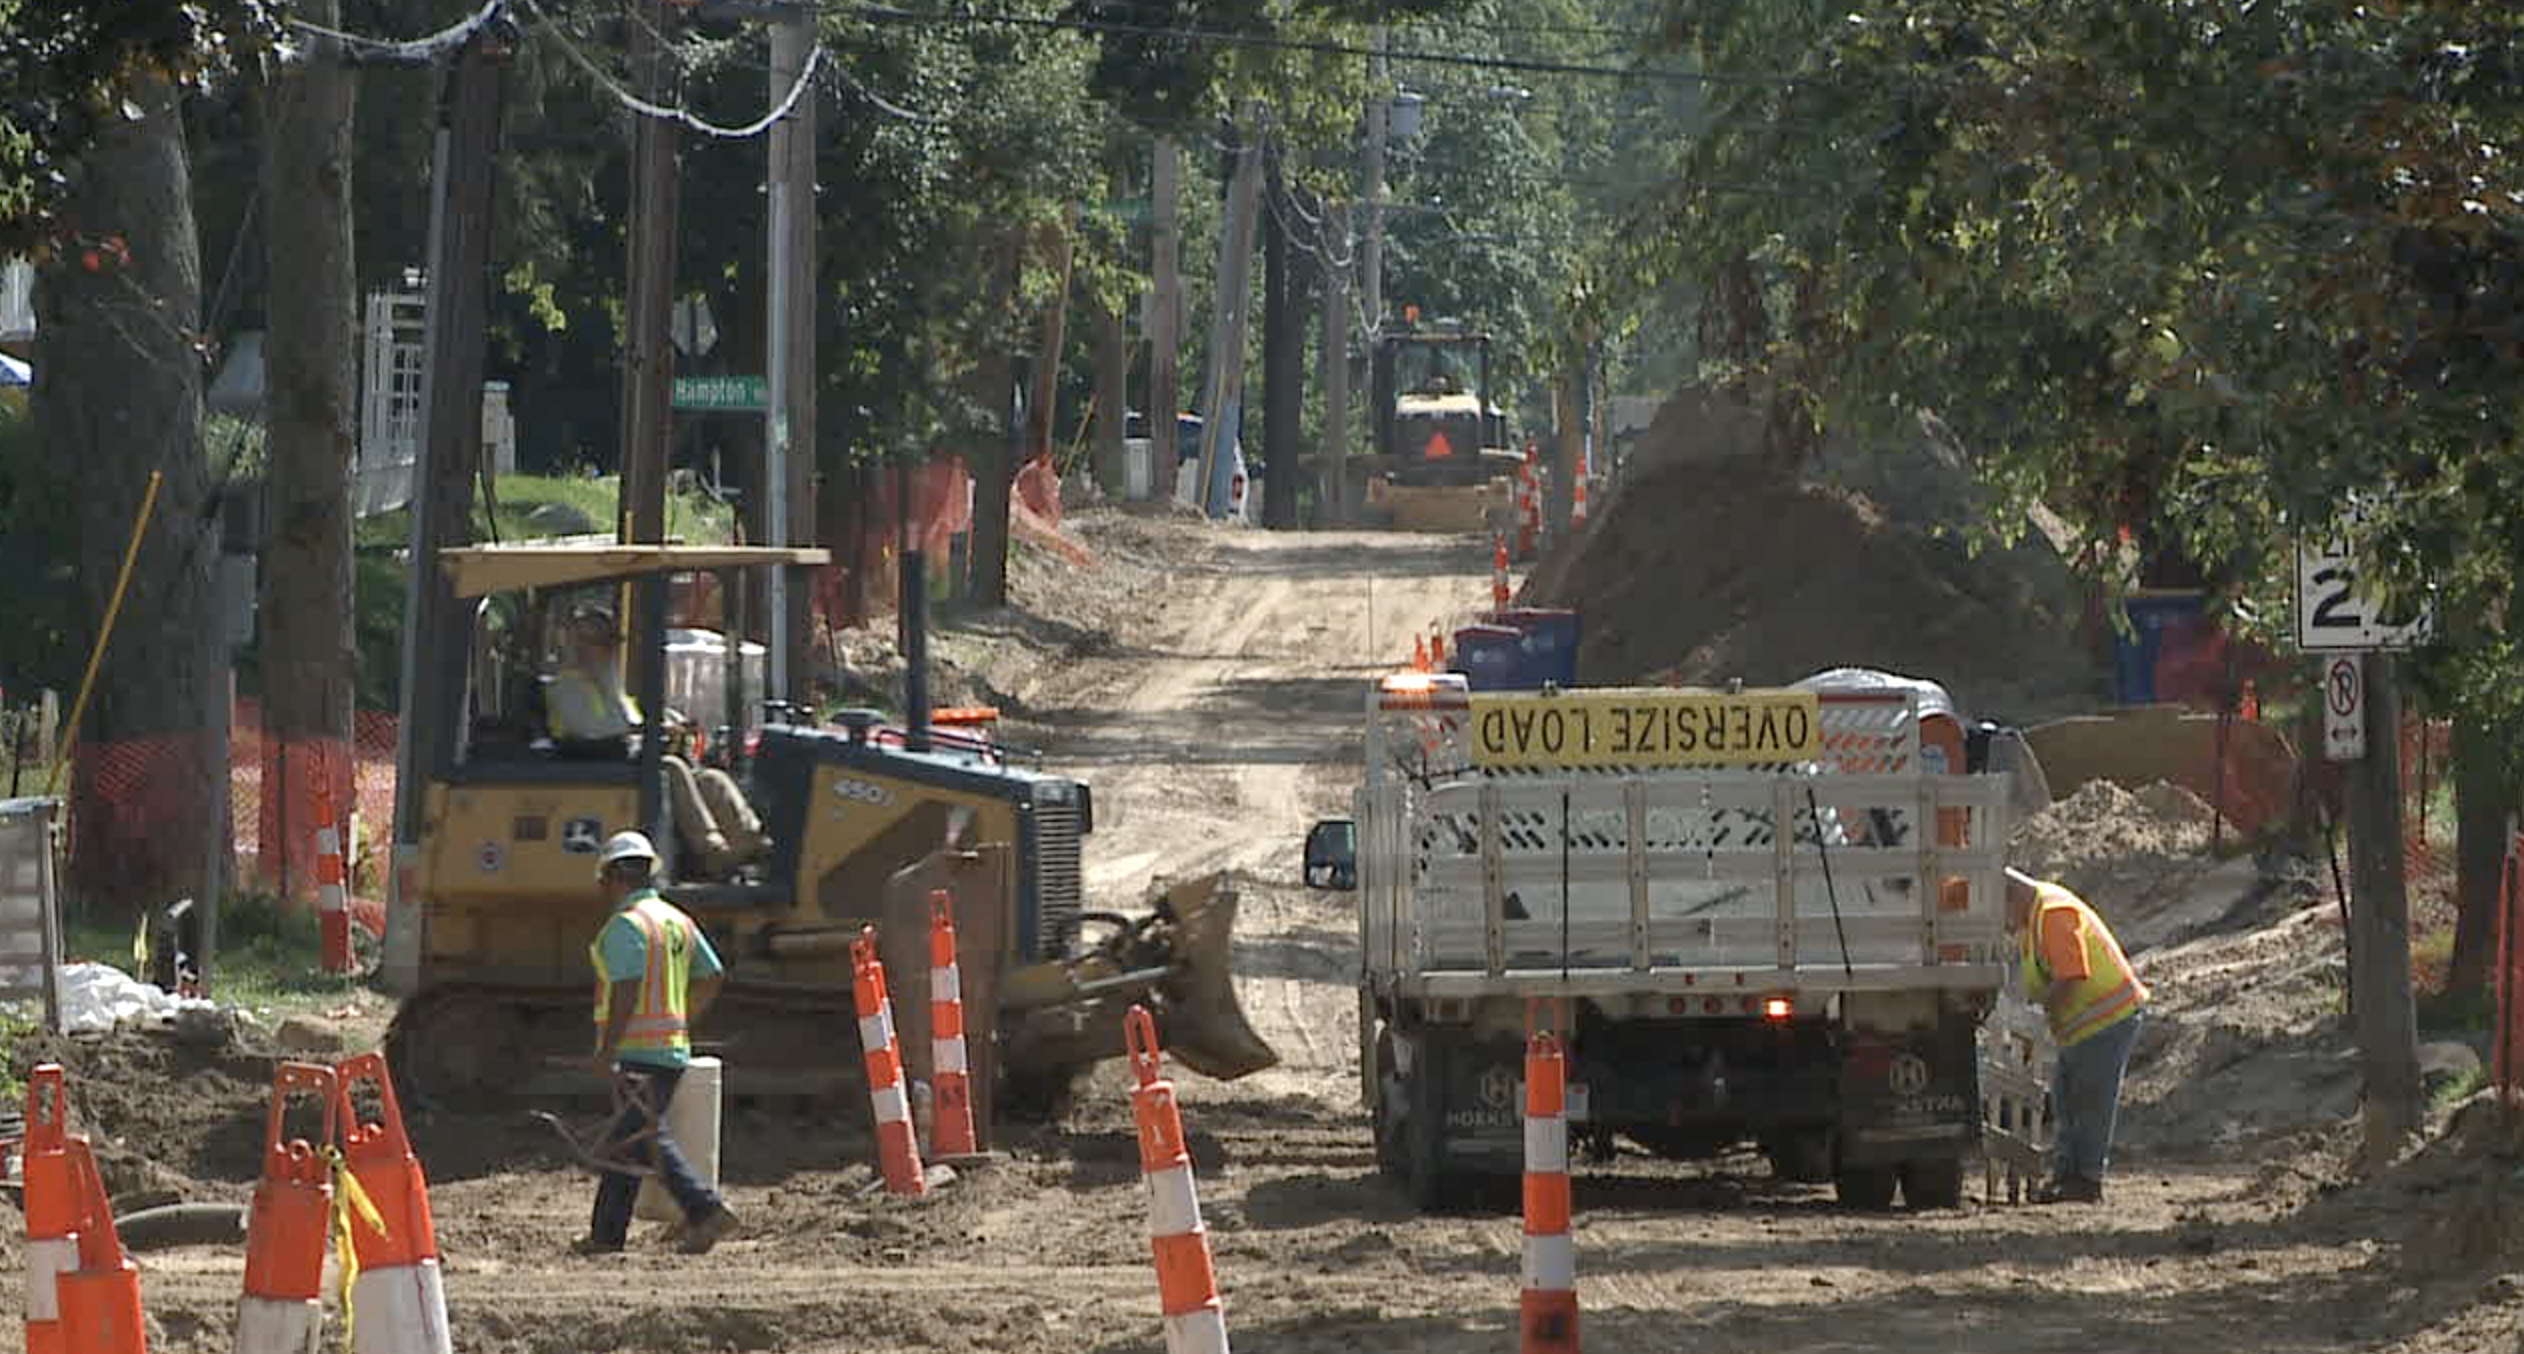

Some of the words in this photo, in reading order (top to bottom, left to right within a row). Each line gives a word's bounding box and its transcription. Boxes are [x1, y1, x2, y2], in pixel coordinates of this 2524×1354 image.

[675, 379, 747, 406] Hampton
[1482, 706, 1592, 753] LOAD
[1611, 704, 1809, 752] OVERSIZE
